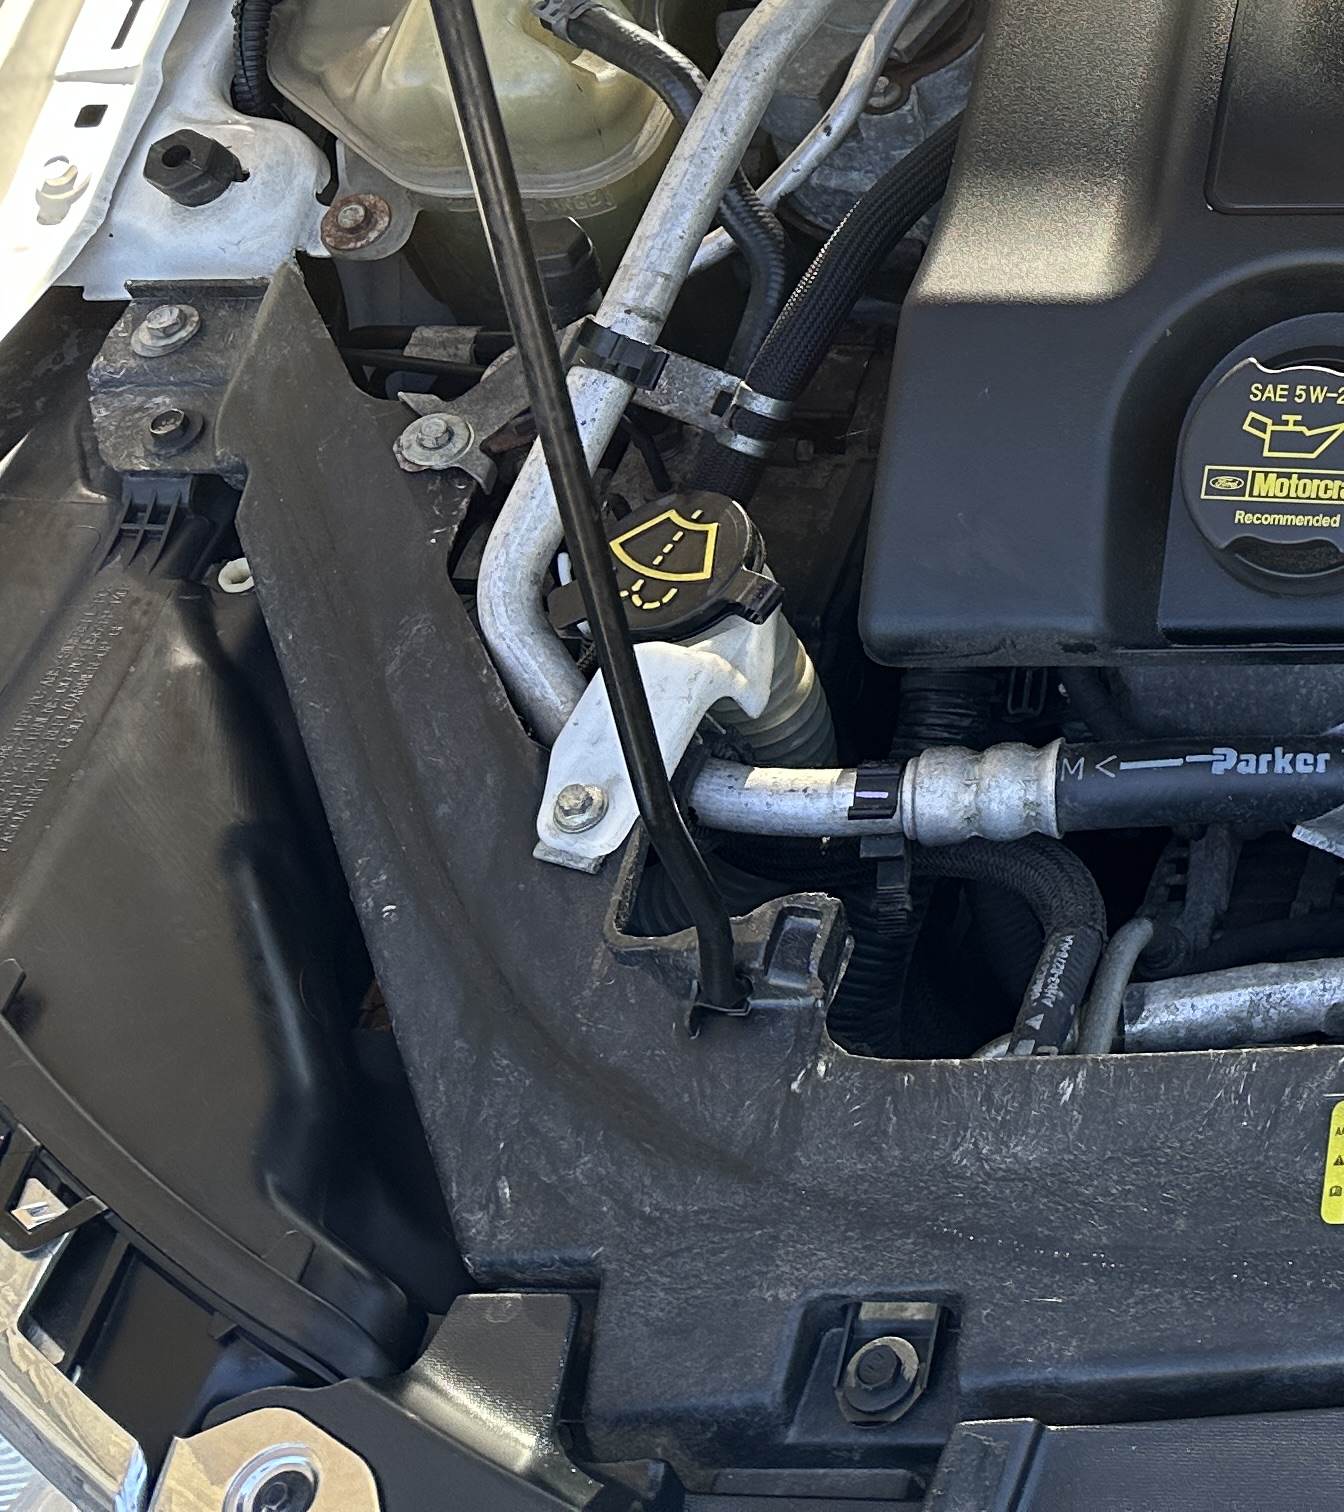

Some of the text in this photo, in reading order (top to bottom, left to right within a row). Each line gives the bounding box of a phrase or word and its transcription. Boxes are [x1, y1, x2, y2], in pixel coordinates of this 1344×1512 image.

[1249, 383, 1289, 403] SAE
[1234, 510, 1341, 528] Recommended
[1211, 746, 1331, 775] Parker
